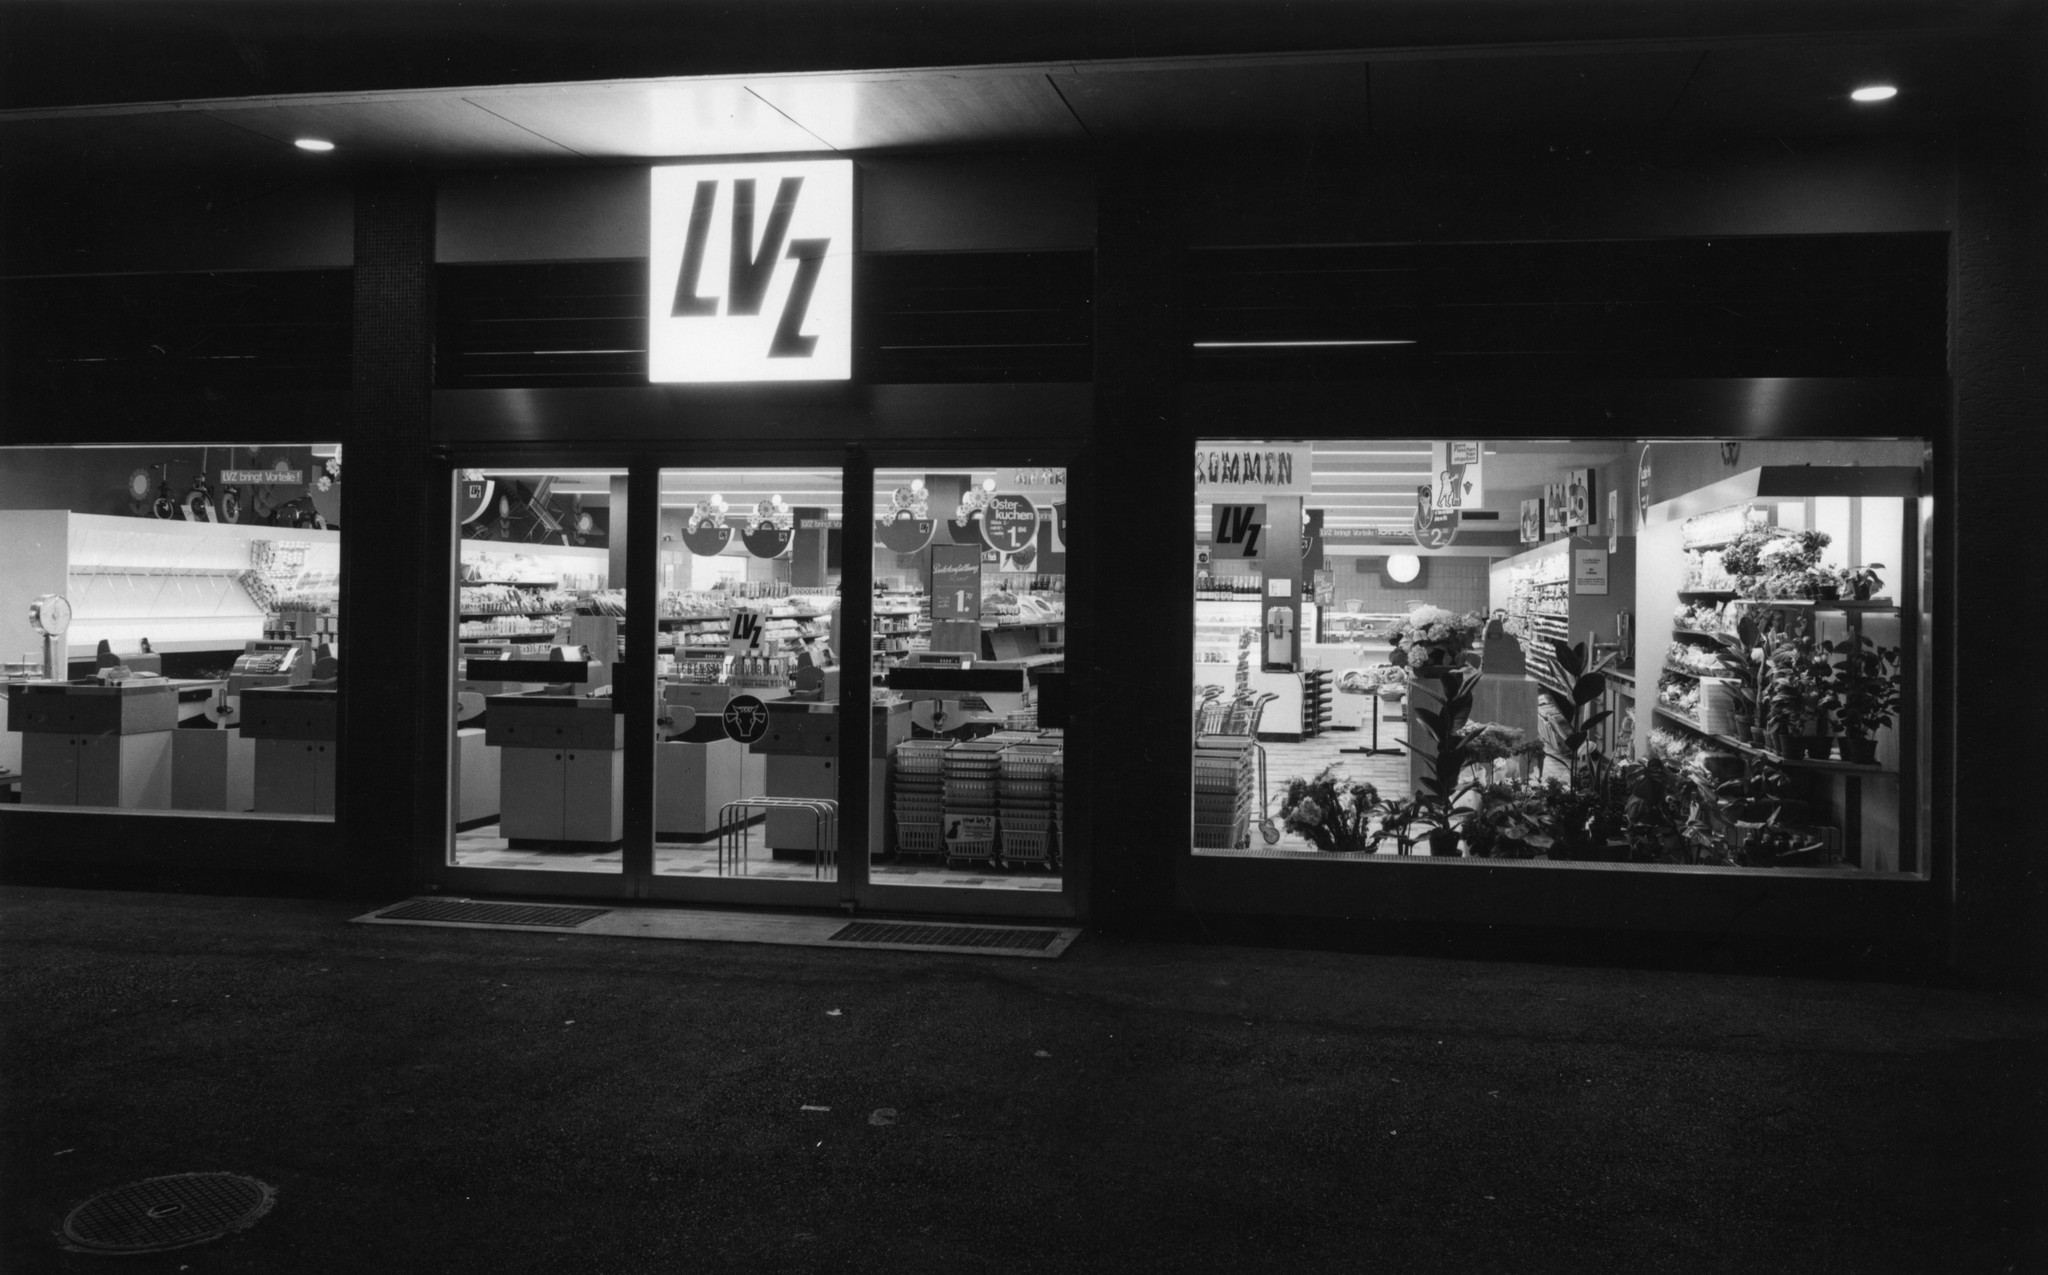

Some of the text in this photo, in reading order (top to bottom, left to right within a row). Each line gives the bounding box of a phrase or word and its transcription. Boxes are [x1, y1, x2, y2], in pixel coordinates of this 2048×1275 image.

[670, 176, 832, 359] LVZ
[222, 471, 238, 482] LVZ
[239, 471, 262, 484] bringt
[990, 498, 1023, 510] Oster-
[995, 510, 1034, 520] kuchen
[1216, 507, 1262, 557] LVZ
[732, 613, 763, 649] LVZ
